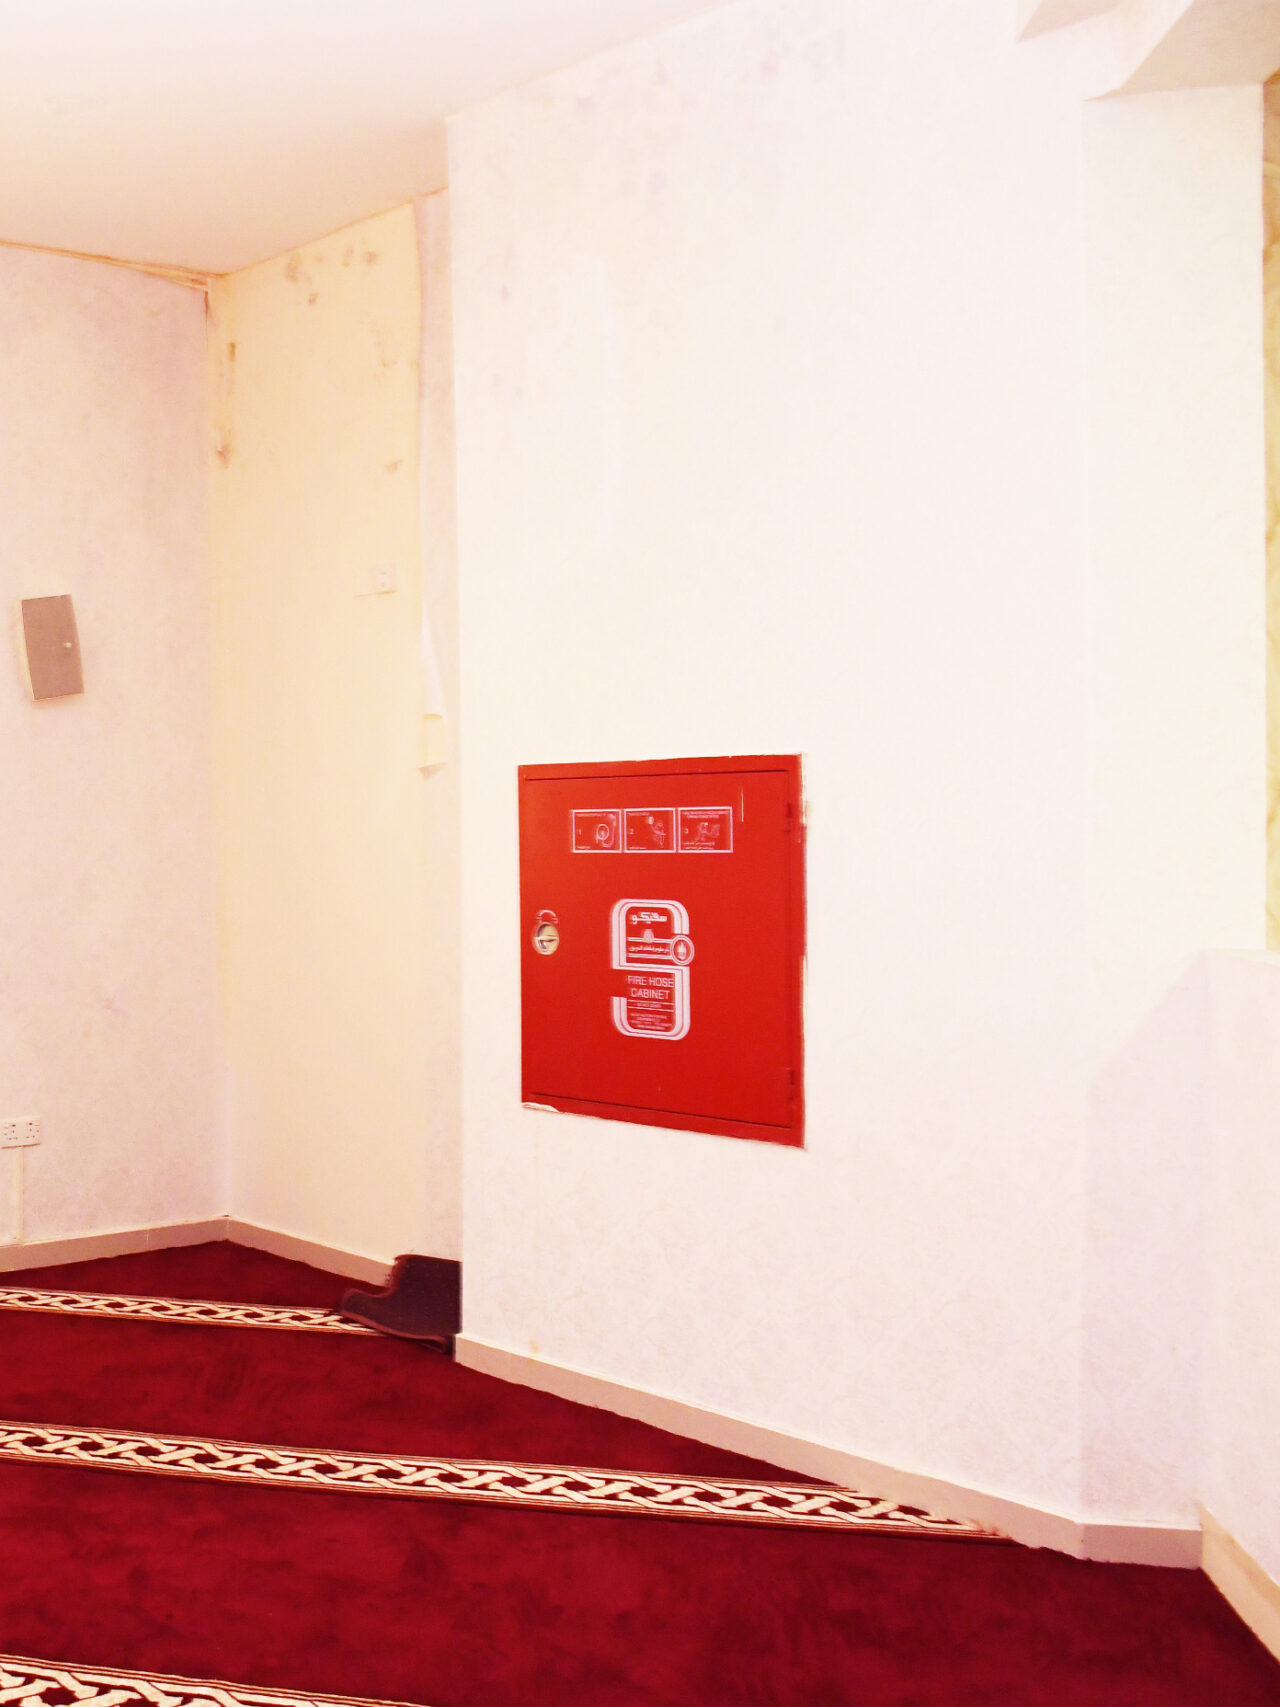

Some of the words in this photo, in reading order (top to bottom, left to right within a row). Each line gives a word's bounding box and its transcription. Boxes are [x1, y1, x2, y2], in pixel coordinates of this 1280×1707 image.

[627, 975, 647, 986] FIRE
[648, 976, 675, 988] HOSE
[631, 987, 670, 1000] CABINET
